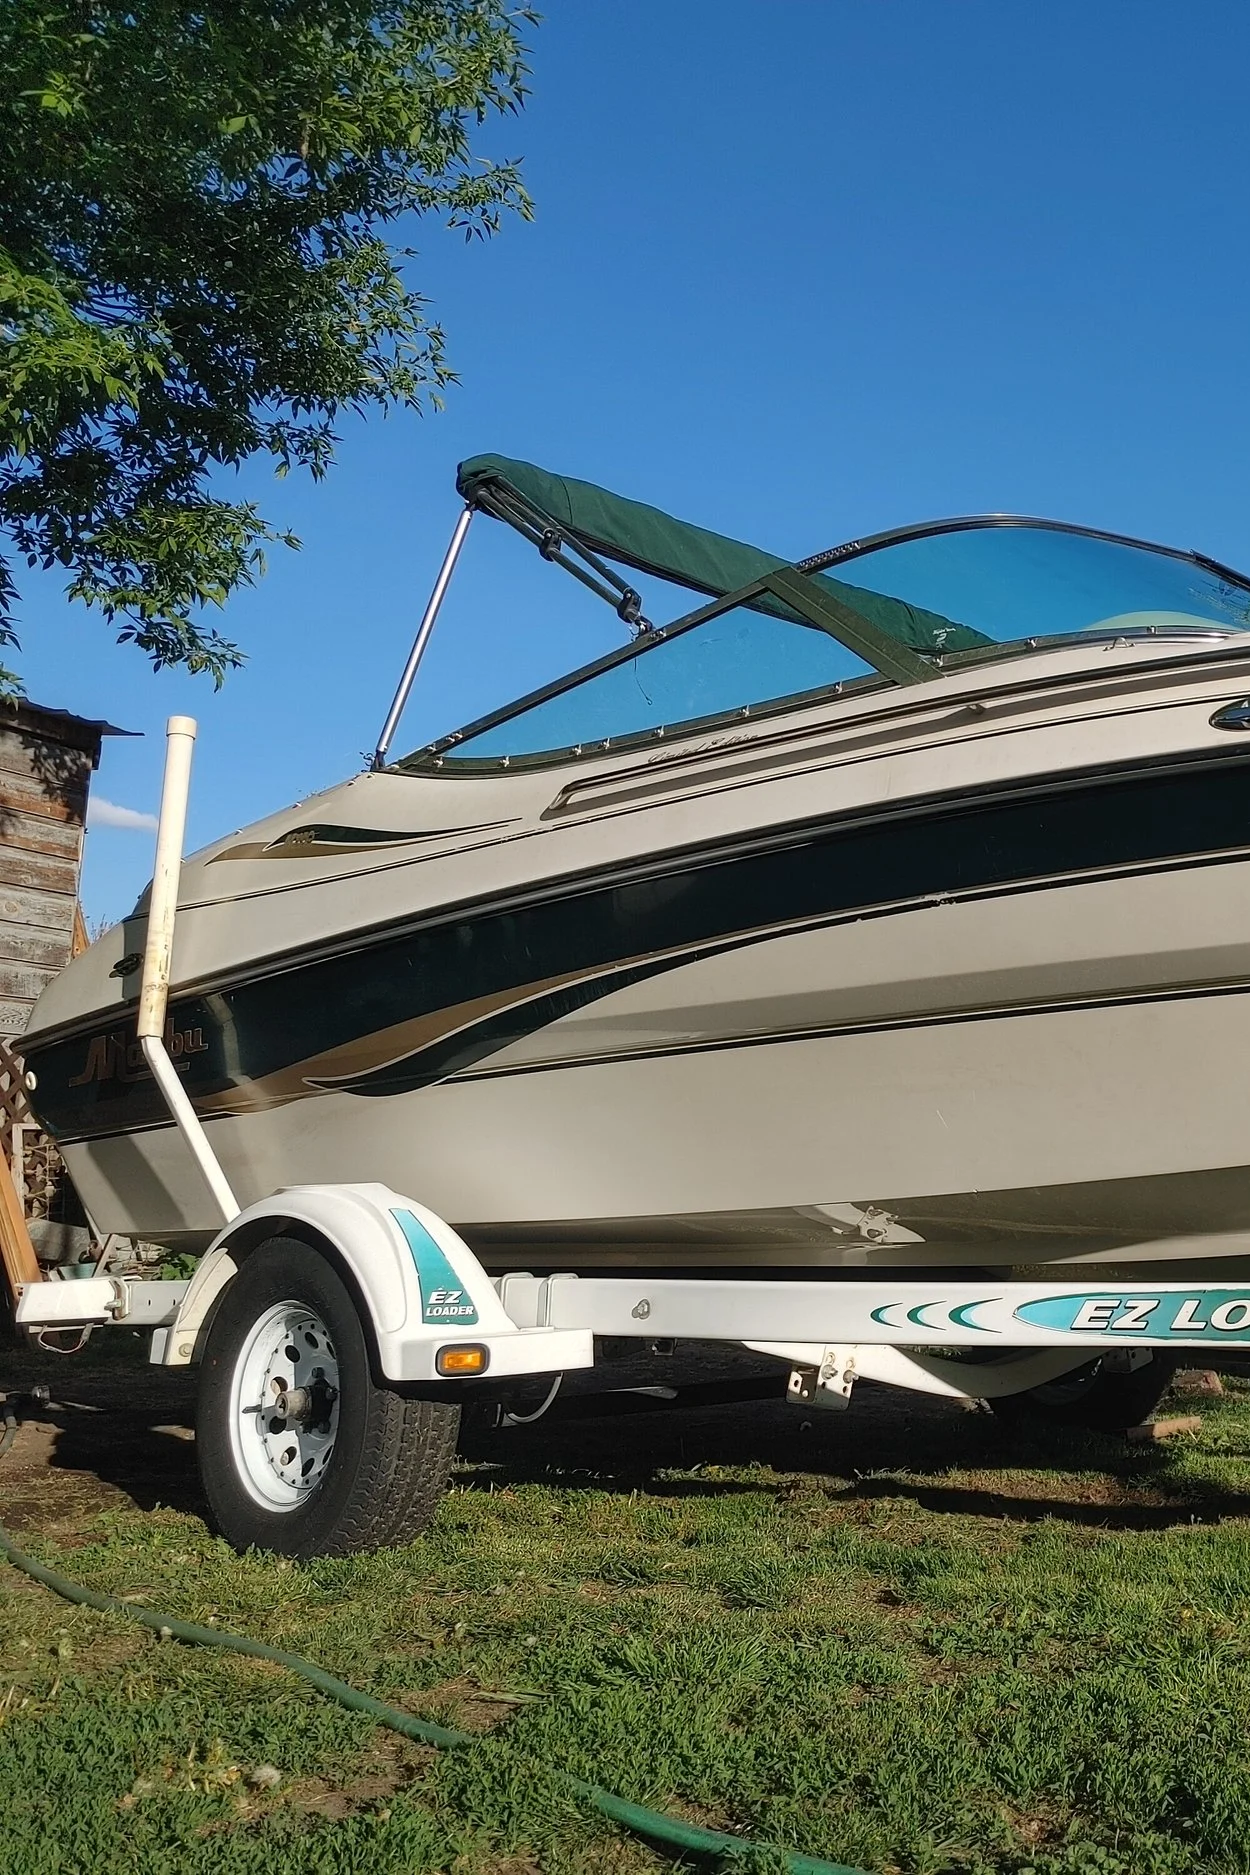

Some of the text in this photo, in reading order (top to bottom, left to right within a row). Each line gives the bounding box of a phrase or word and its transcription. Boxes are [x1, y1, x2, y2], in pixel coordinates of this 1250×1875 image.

[428, 1290, 463, 1305] EZ
[426, 1305, 475, 1317] LOADER
[1070, 1299, 1160, 1331] EZ
